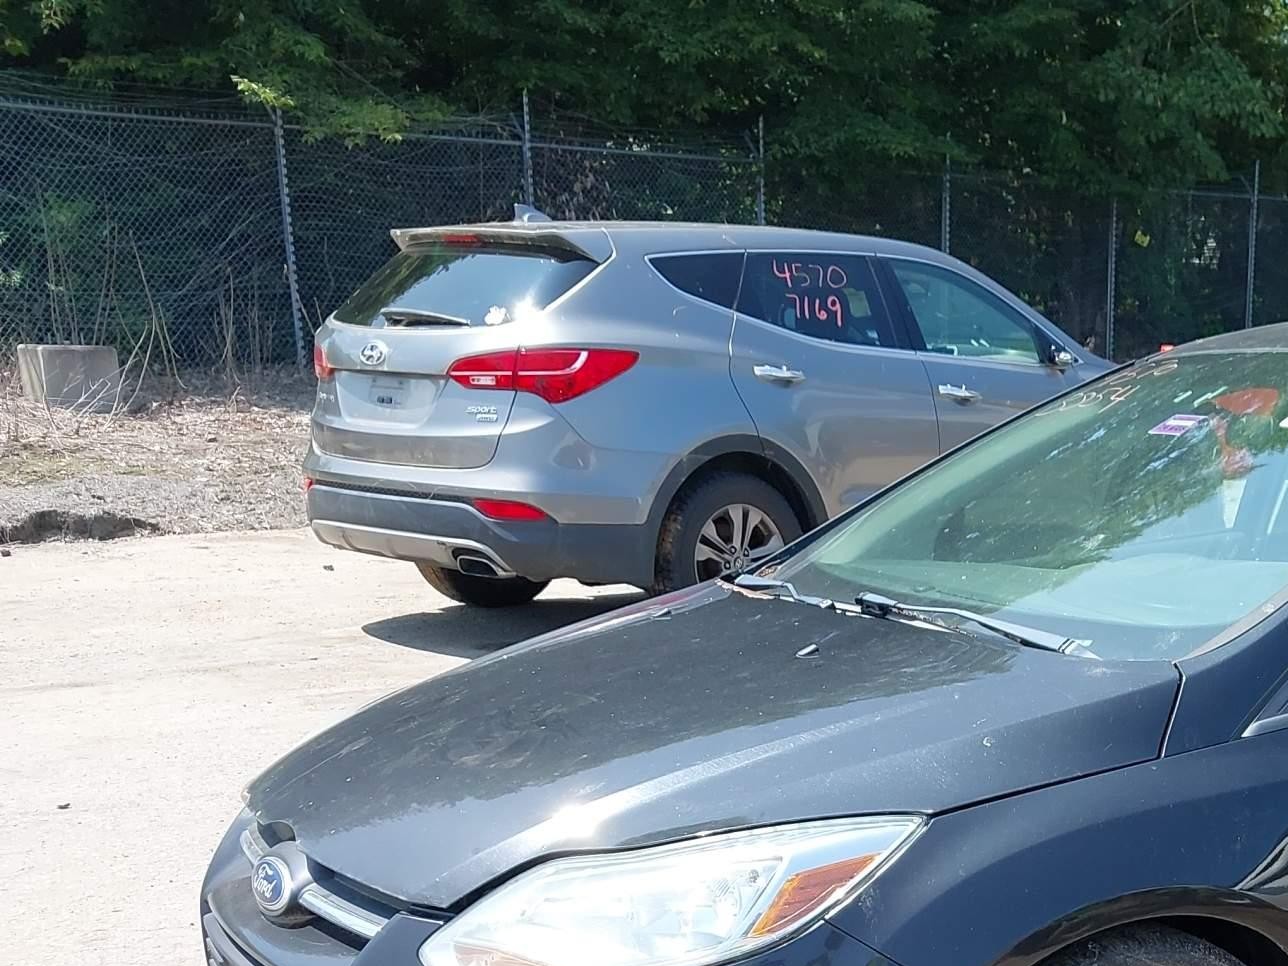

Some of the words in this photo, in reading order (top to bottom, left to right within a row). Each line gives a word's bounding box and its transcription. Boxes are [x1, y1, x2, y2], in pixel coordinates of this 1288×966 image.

[773, 259, 847, 288] 4570
[785, 293, 842, 328] 7169
[254, 863, 278, 898] Ford
